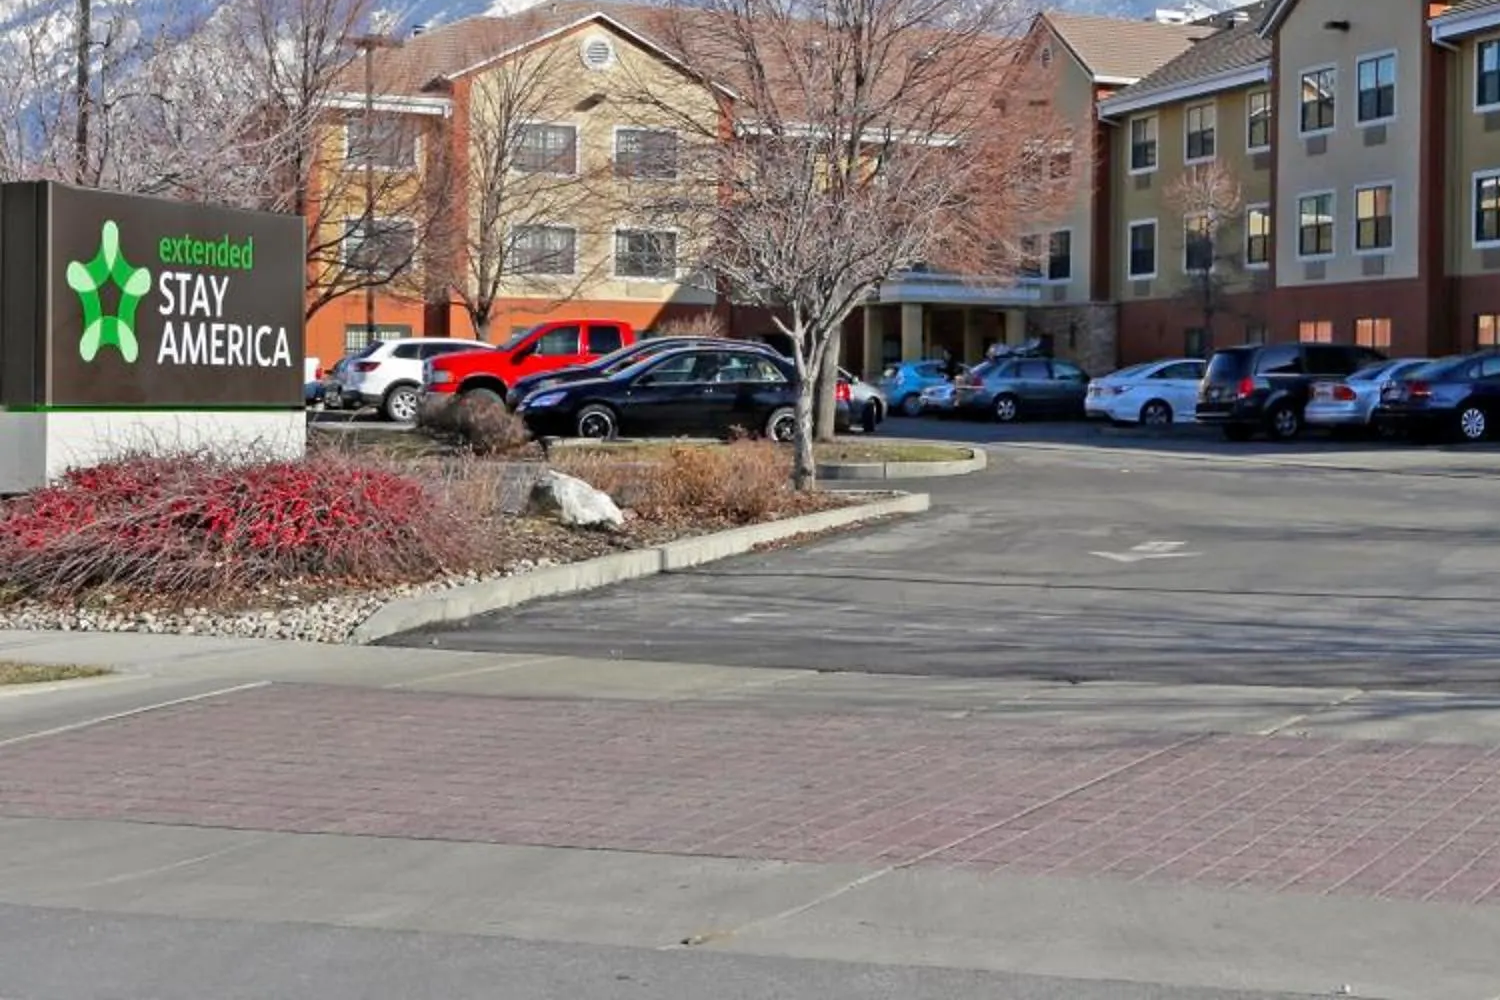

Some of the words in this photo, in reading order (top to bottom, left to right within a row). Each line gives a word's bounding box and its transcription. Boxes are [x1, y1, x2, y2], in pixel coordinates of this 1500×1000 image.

[159, 234, 254, 269] extended
[158, 271, 229, 317] STAY
[157, 321, 292, 367] AMERICA
